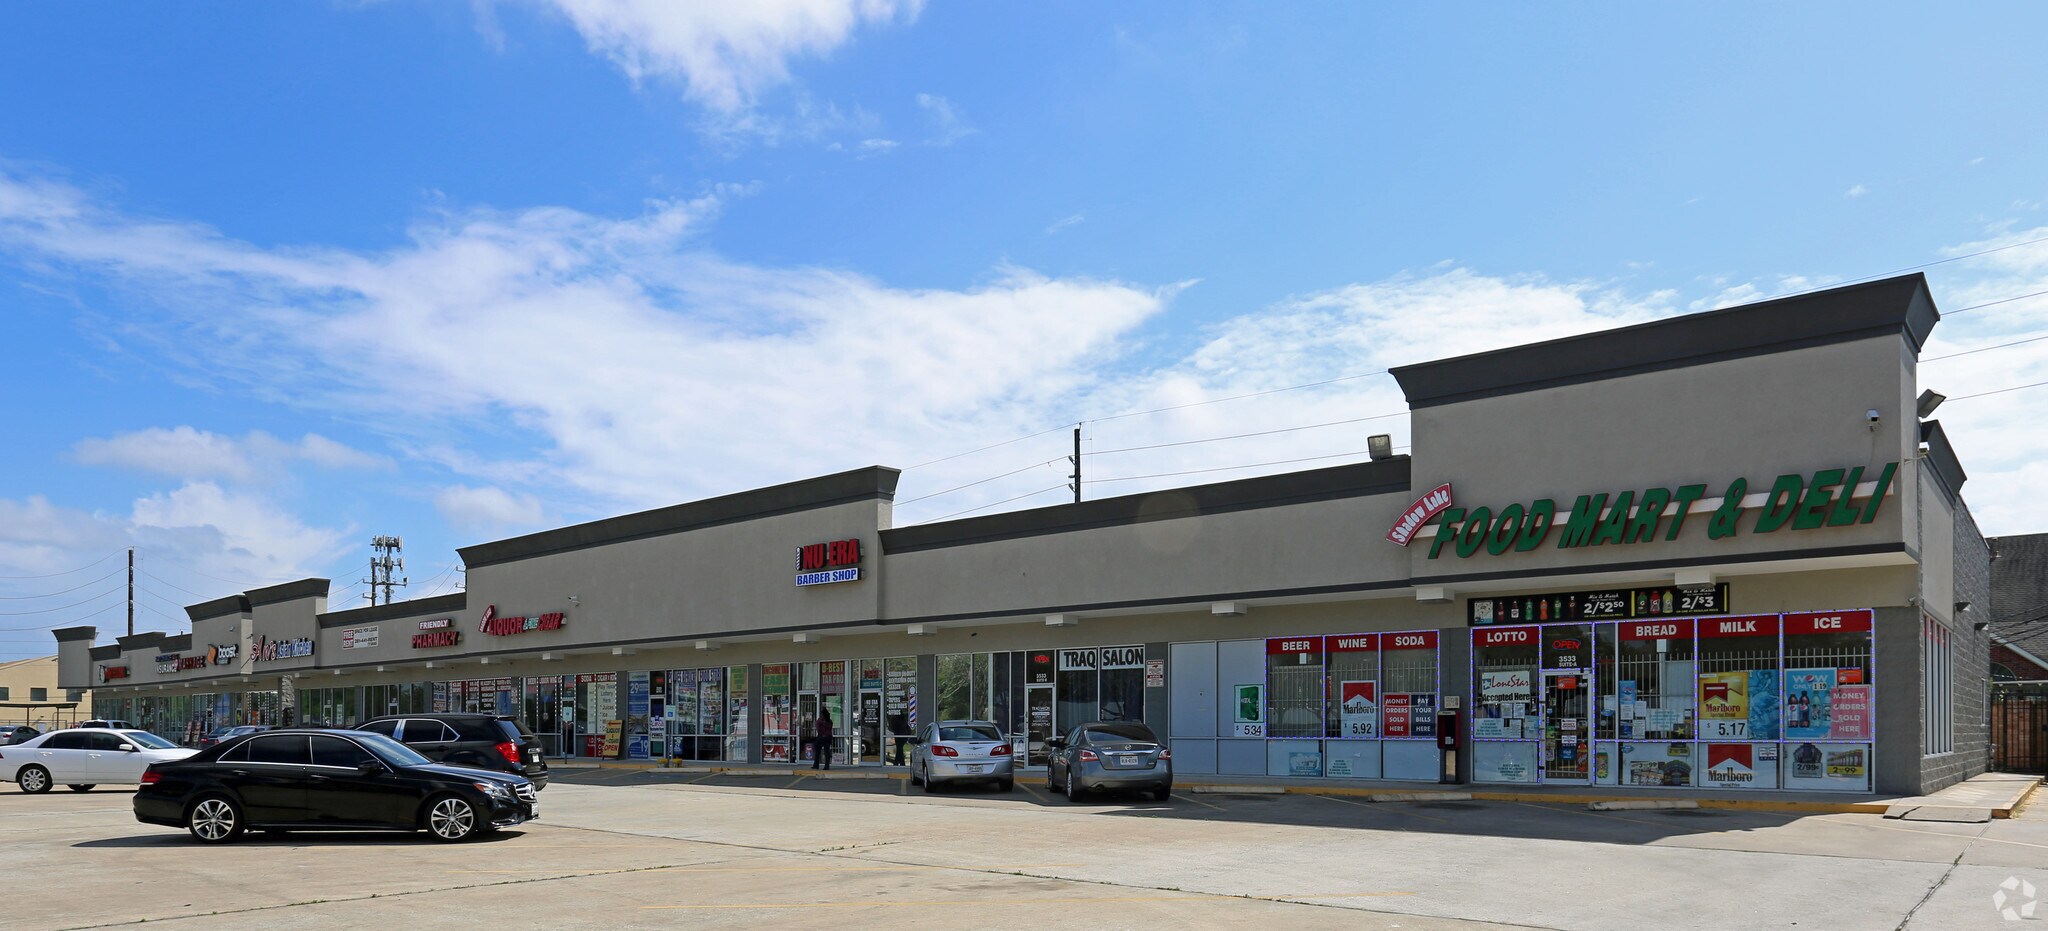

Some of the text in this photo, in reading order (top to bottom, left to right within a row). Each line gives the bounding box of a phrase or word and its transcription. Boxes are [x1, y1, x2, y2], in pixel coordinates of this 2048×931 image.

[1428, 462, 1900, 559] FOOD MART & DELI
[803, 538, 860, 570] NU ERA
[797, 569, 857, 585] BARBER SHOP
[1682, 596, 1714, 609] 2/$3
[419, 620, 449, 630] FRIENDLY
[489, 616, 523, 637] LIQUOR
[1719, 621, 1756, 633] MILK
[1814, 616, 1841, 629] ICE
[1487, 631, 1528, 643] LOTTO
[1636, 625, 1677, 637] BREAD
[412, 632, 458, 648] PHARMACY
[1282, 641, 1310, 651] BEER
[1338, 638, 1367, 649] WINE
[1395, 636, 1425, 647] SODA
[1552, 640, 1581, 650] OPEN
[218, 645, 236, 658] boost
[1064, 648, 1144, 669] TRAQ SALON
[581, 675, 592, 683] SODA
[1792, 674, 1828, 683] WOW
[630, 683, 639, 694] 29
[1482, 692, 1530, 702] Accepted Here
[1833, 692, 1865, 700] MONEY
[1343, 701, 1375, 714] Marlboro
[1705, 703, 1741, 713] Marlboro
[1832, 703, 1866, 711] ORDERS
[1352, 723, 1372, 734] 5.92
[1718, 723, 1746, 736] 5.17
[1708, 767, 1753, 782] Marlboro
